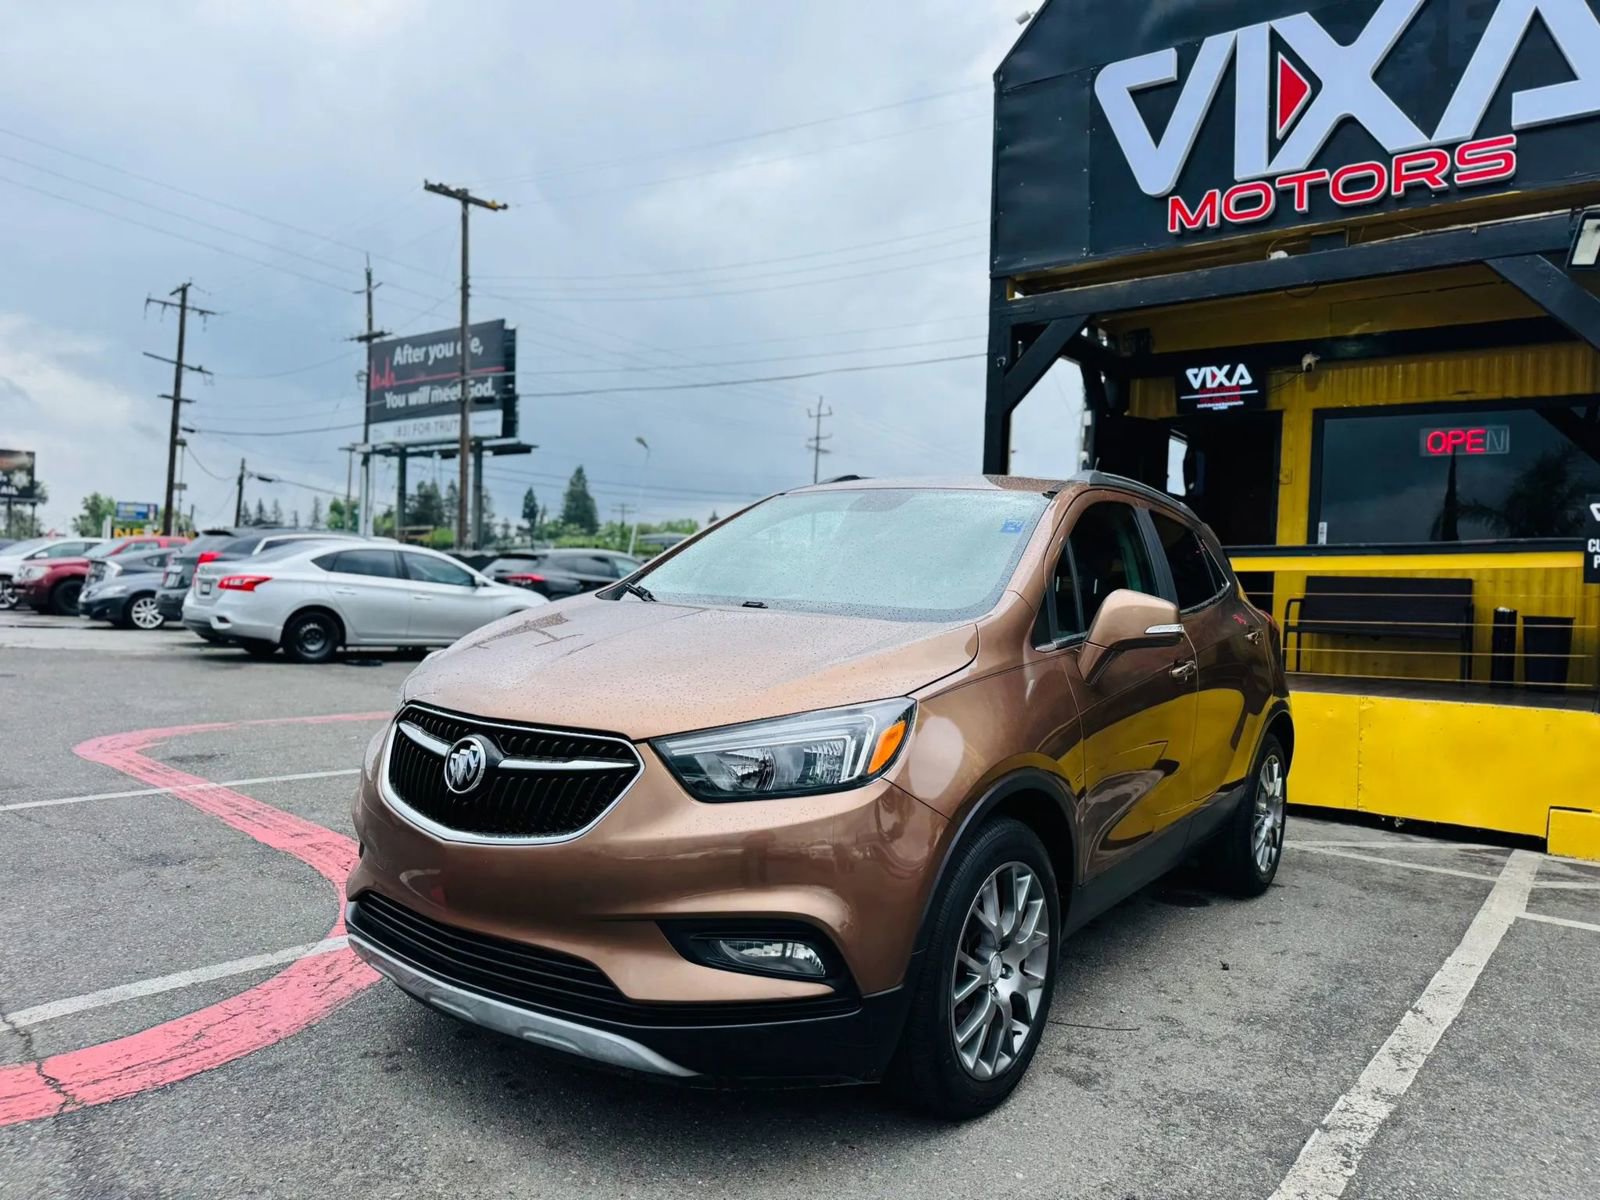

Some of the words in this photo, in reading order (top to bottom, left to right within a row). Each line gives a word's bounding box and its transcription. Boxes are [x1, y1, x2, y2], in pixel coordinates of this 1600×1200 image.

[1094, 0, 1600, 198] VIXA
[1167, 133, 1518, 235] MOTORS
[393, 343, 427, 367] After
[428, 340, 454, 366] you
[456, 332, 484, 357] e,
[1185, 363, 1253, 390] VIXA
[384, 390, 406, 409] You
[407, 385, 431, 406] will
[1426, 428, 1506, 455] OPEN
